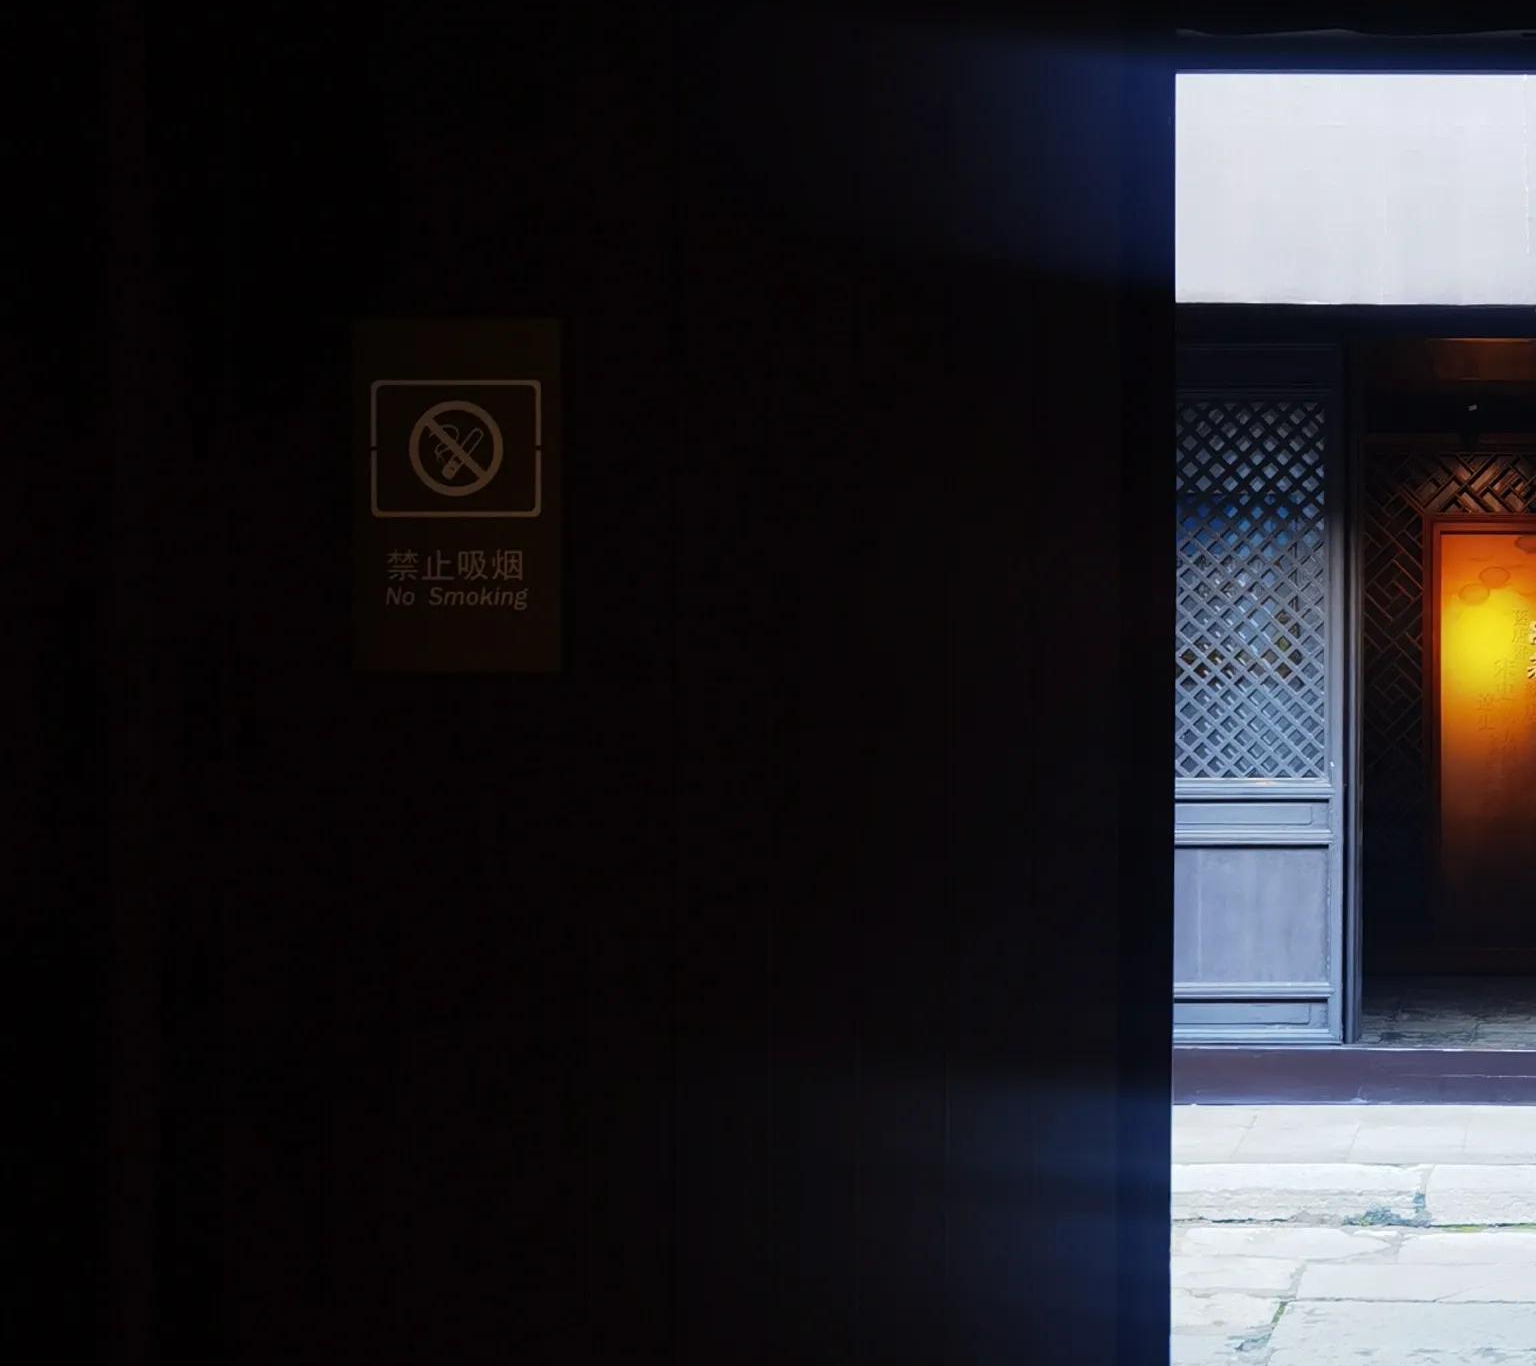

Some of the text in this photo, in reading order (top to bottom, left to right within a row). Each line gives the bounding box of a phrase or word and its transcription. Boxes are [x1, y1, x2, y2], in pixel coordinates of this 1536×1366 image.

[384, 548, 524, 582] 禁止吸烟
[385, 586, 529, 611] No Smoking
